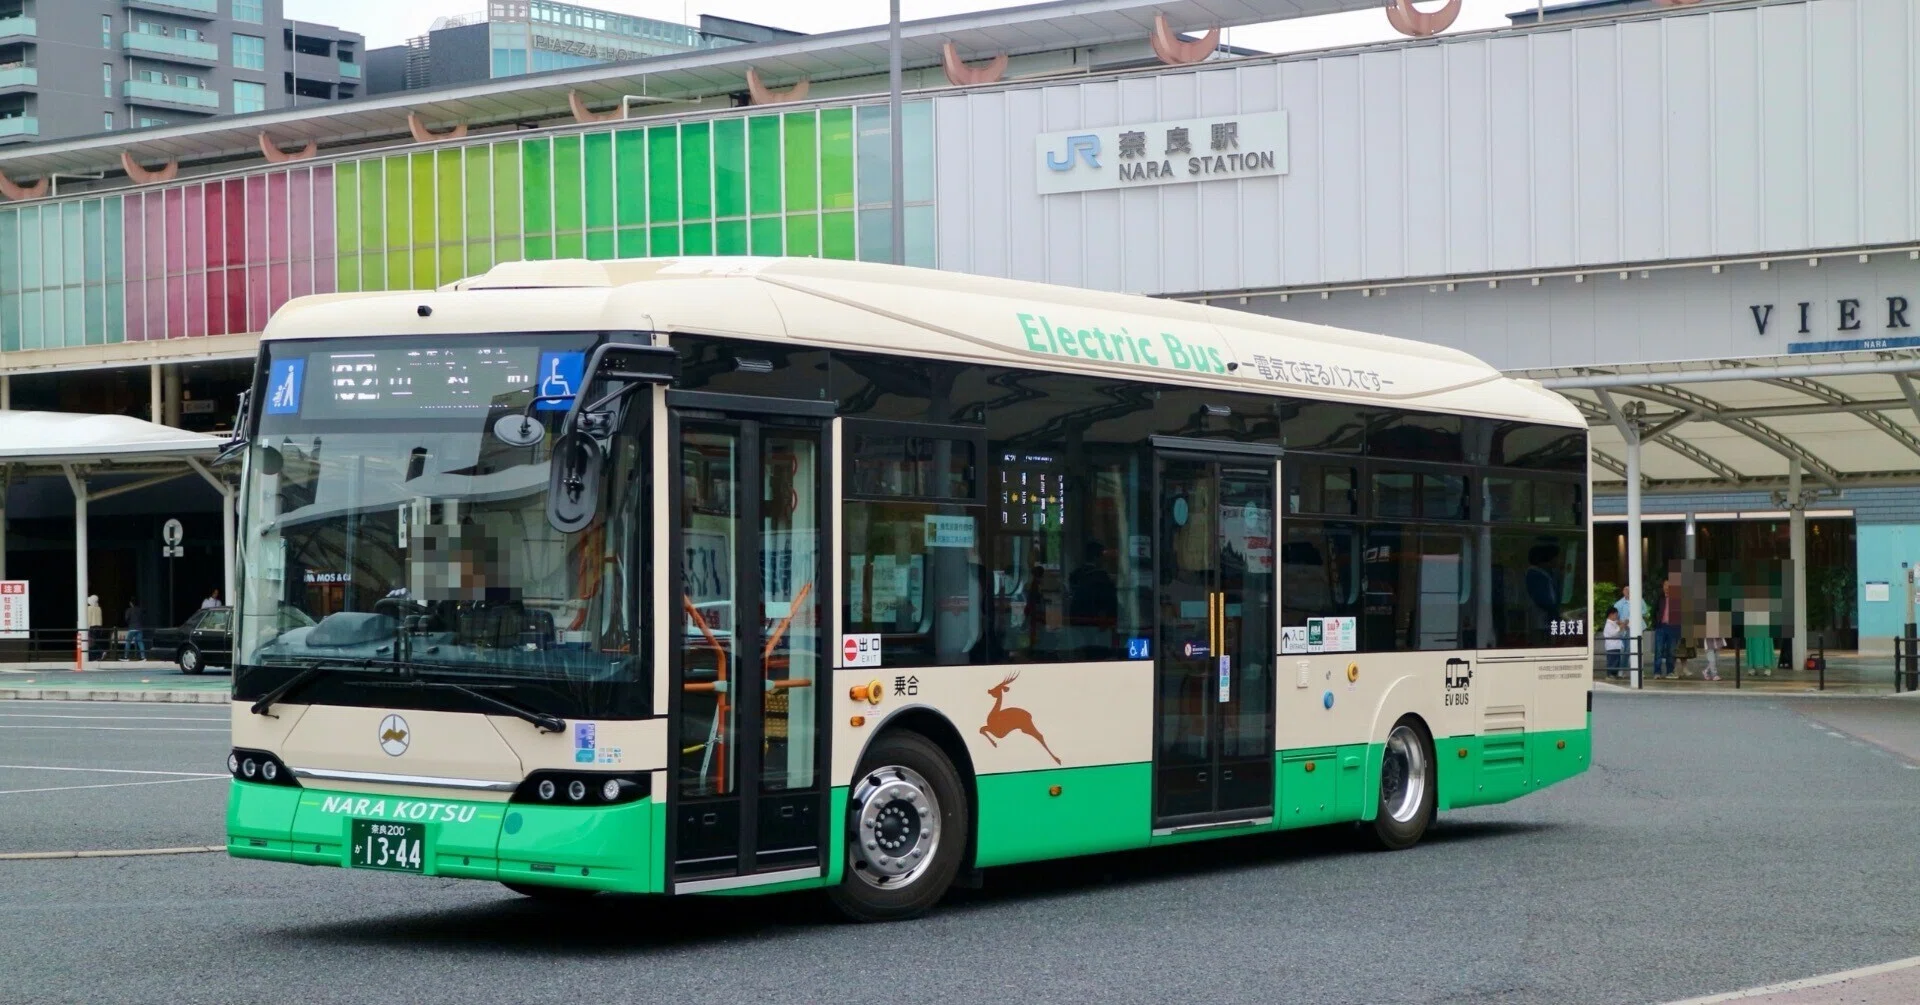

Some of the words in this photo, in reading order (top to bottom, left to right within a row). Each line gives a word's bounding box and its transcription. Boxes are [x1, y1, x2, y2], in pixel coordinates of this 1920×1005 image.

[535, 34, 598, 58] PIAZZA
[1118, 122, 1239, 160] 奈良駅
[1047, 134, 1102, 172] JR
[1119, 160, 1174, 181] NARA
[1188, 151, 1275, 175] STATION
[1016, 313, 1159, 366] Electric
[1161, 332, 1225, 374] Bus
[1863, 340, 1887, 349] NARA
[317, 573, 336, 582] MOS
[1550, 619, 1584, 636] 奈良交通
[859, 637, 880, 652] 出口
[894, 675, 919, 696] 乗合
[1445, 694, 1455, 706] EV
[1455, 693, 1469, 705] BUS
[321, 796, 385, 817] NARA
[392, 801, 477, 823] KOTSU
